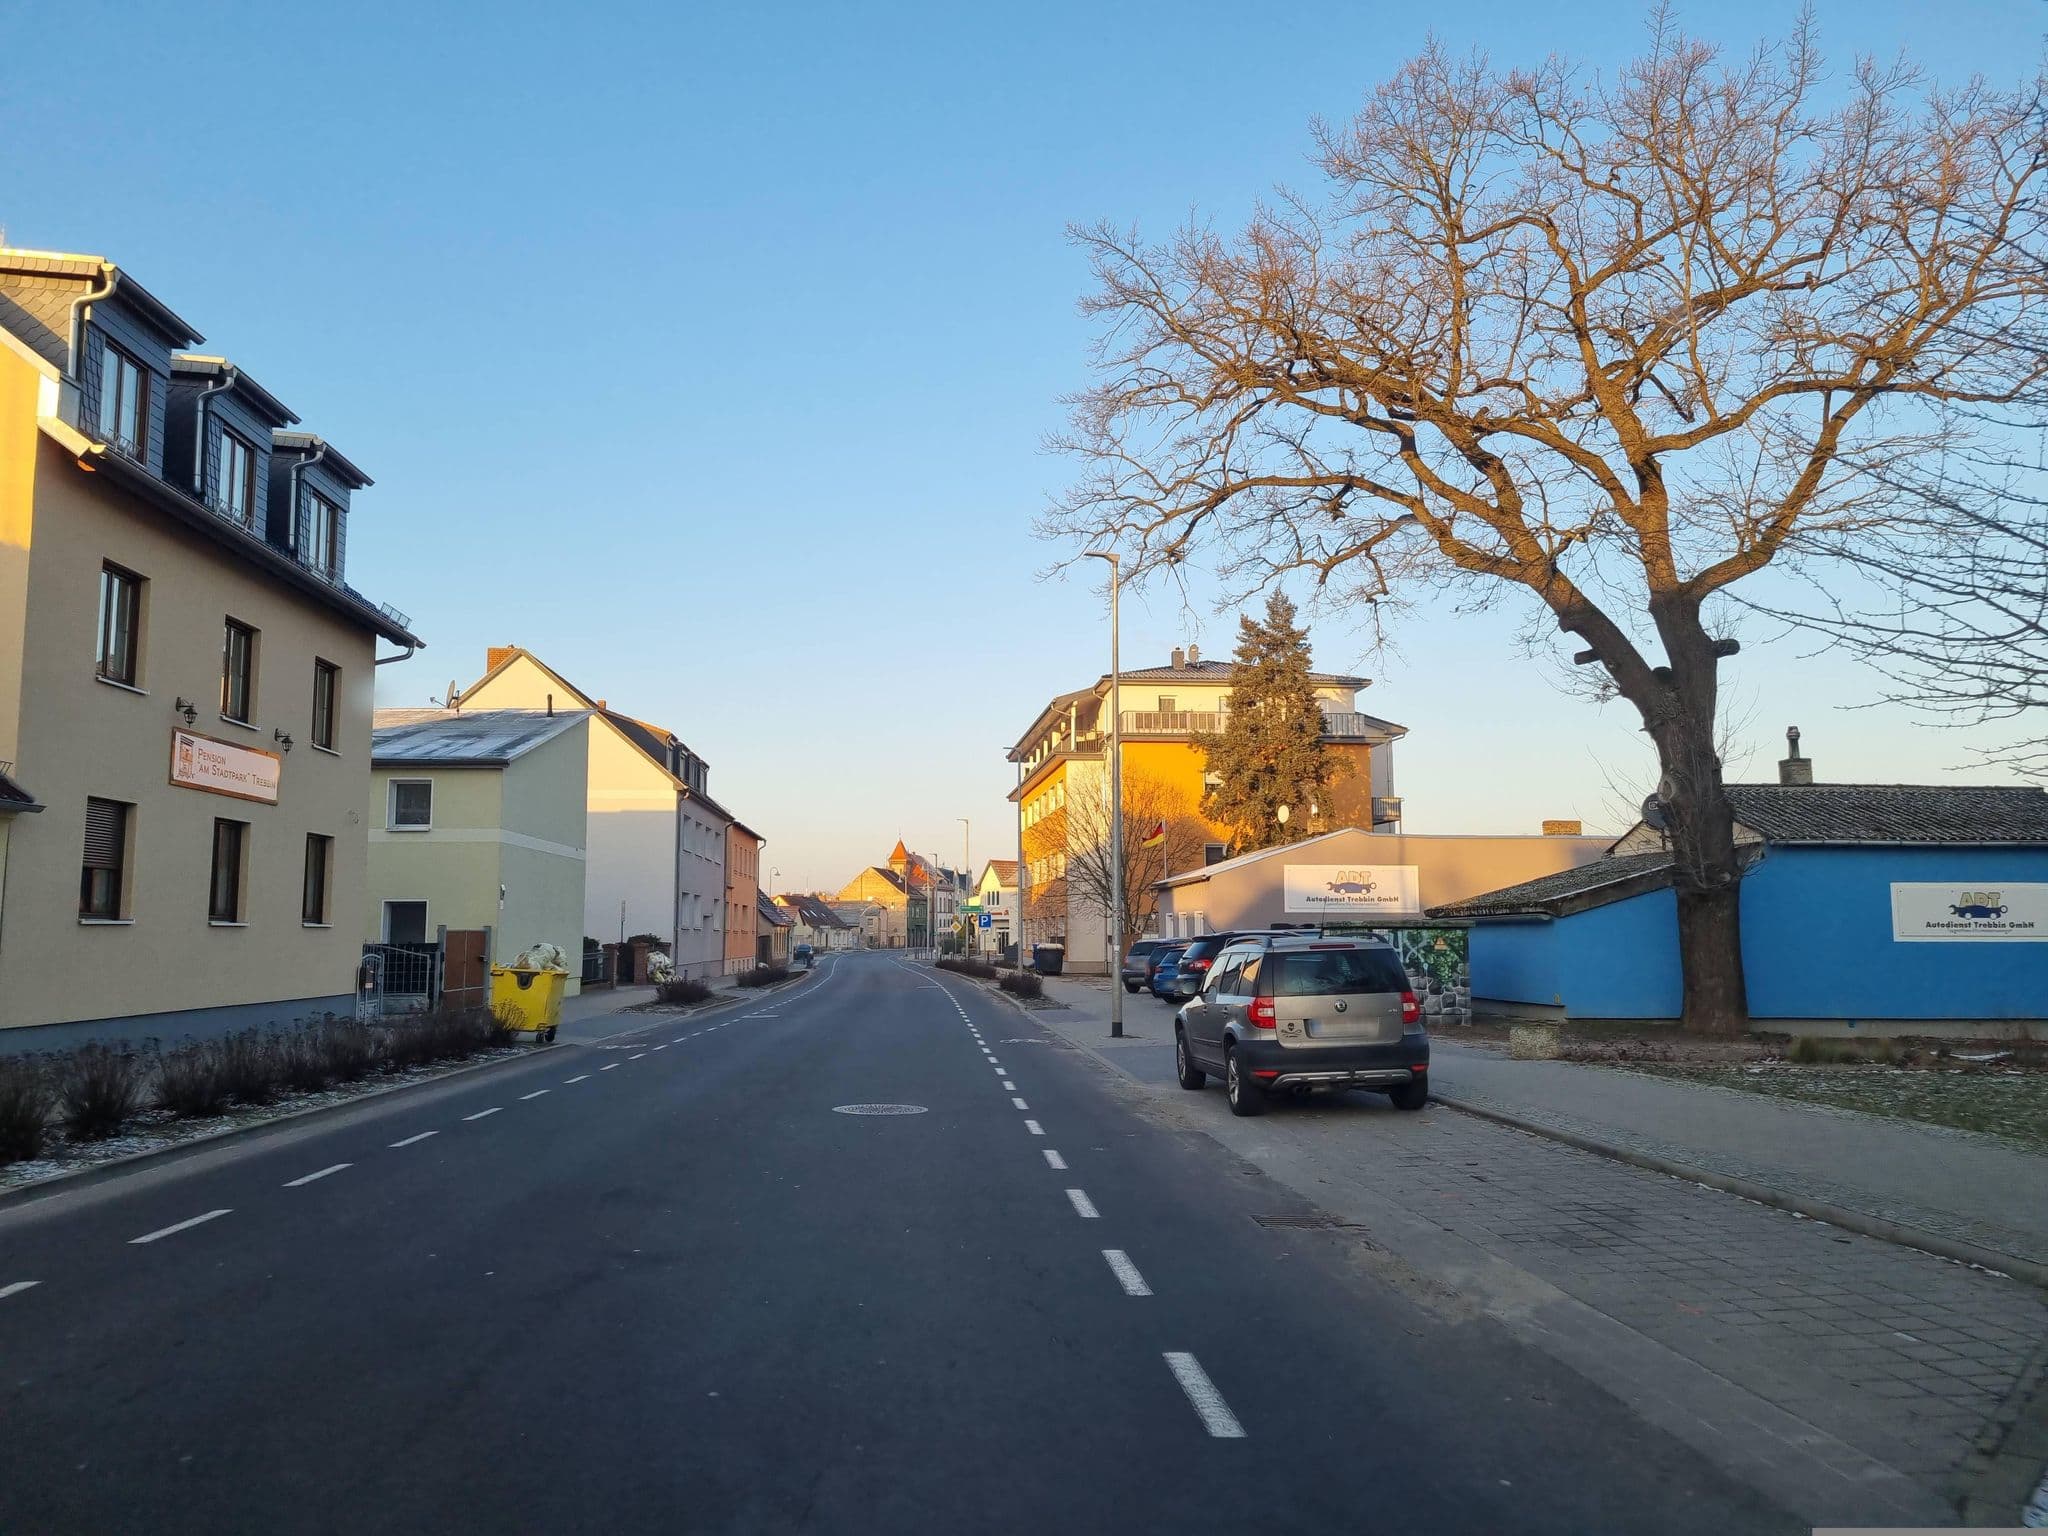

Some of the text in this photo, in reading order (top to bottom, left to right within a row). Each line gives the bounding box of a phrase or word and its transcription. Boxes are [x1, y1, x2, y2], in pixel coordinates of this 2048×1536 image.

[1336, 870, 1371, 885] ADT
[1959, 891, 2001, 908] ADT
[1925, 921, 2035, 929] Autodienst Trebbin GmbH
